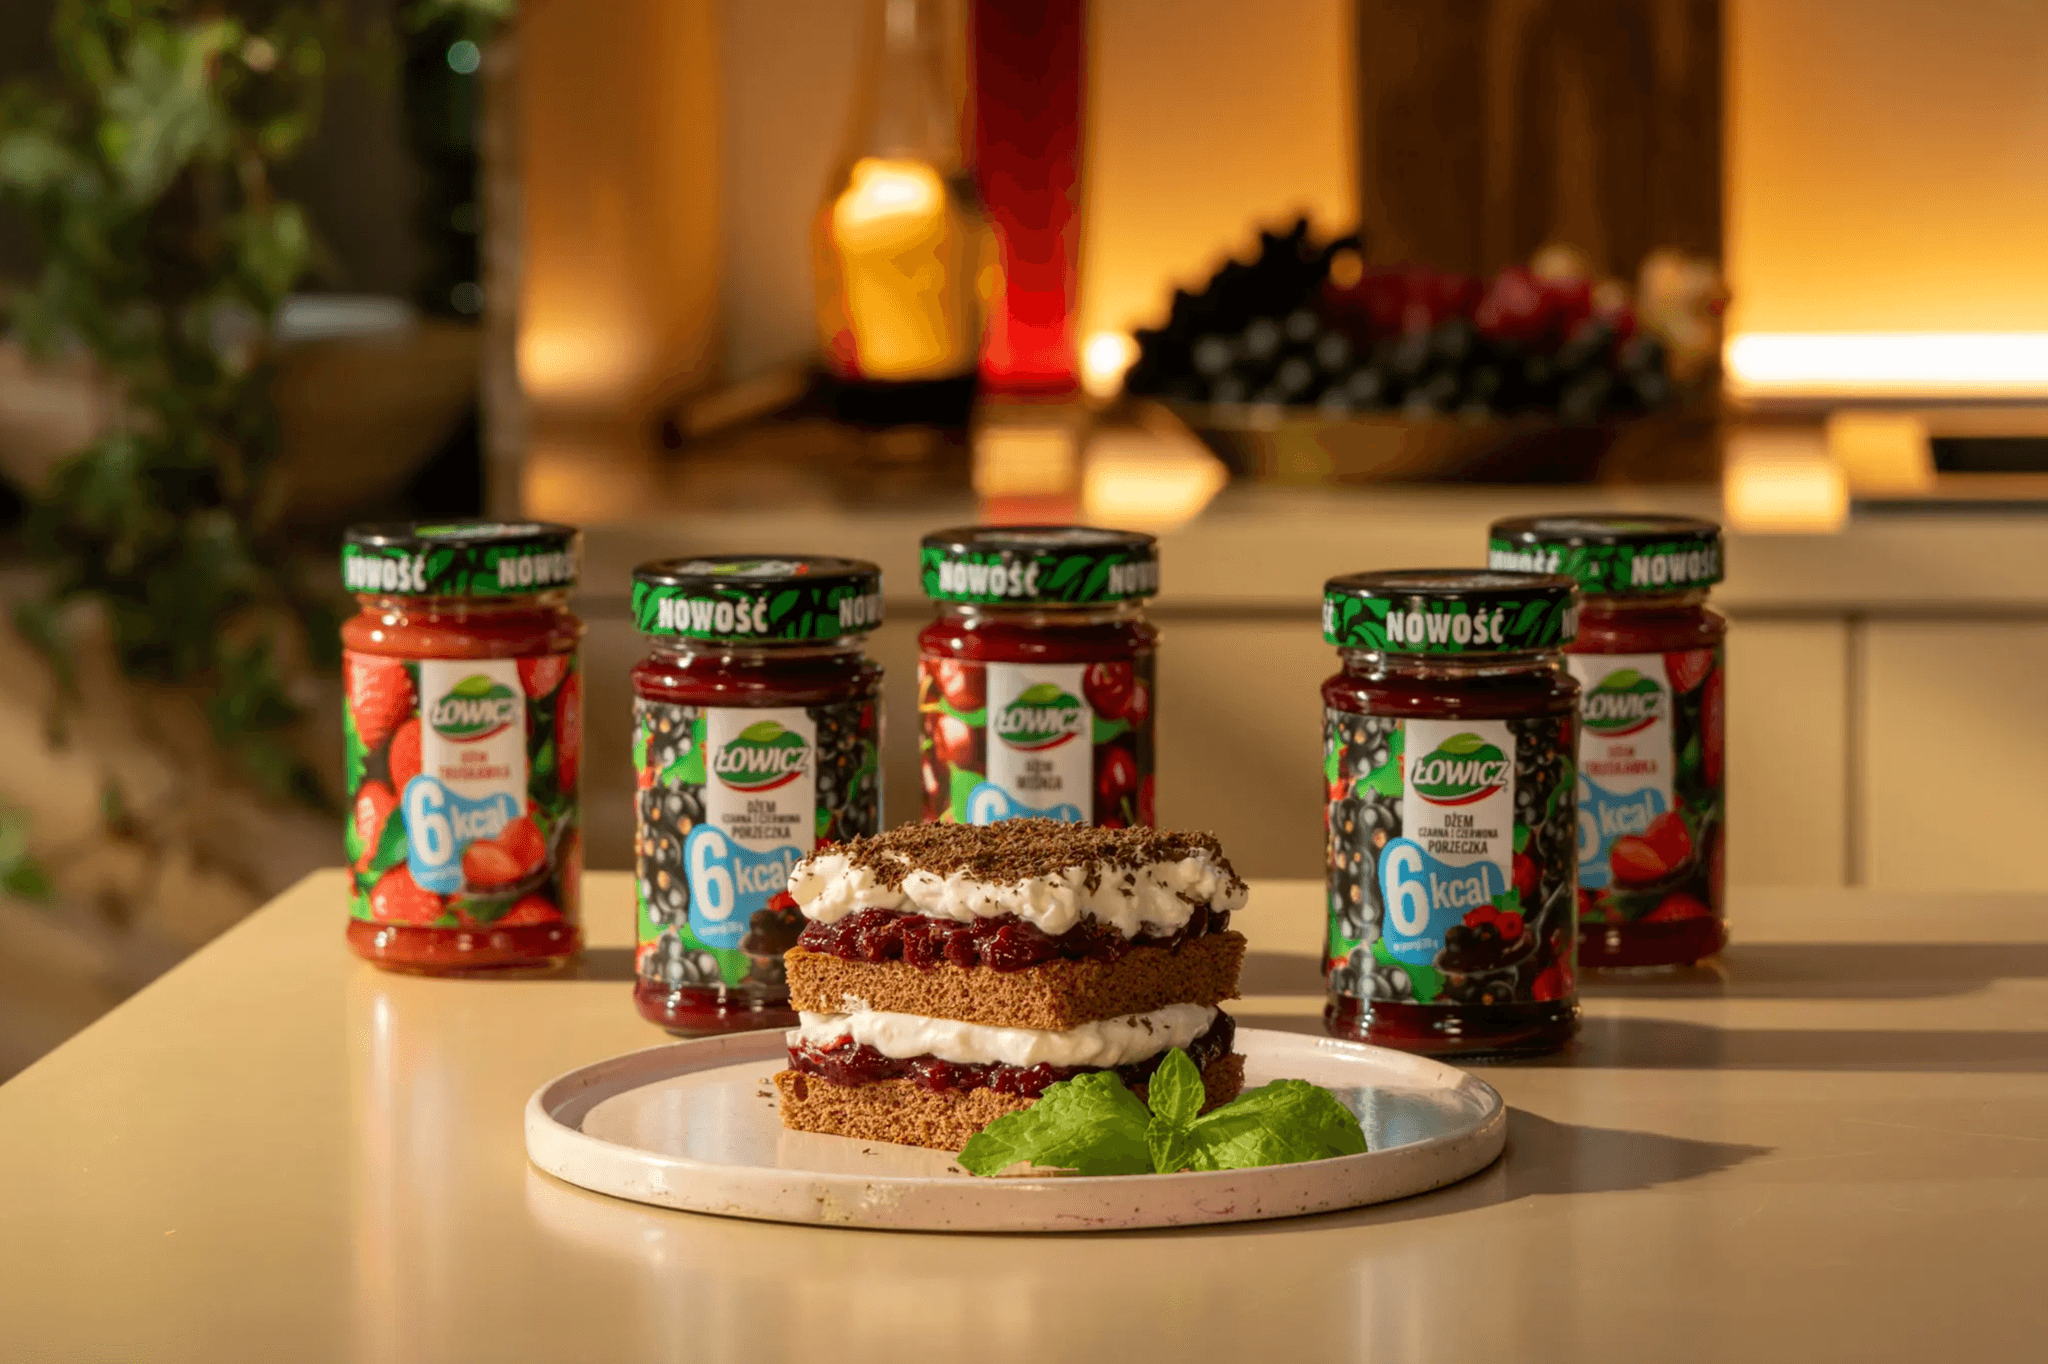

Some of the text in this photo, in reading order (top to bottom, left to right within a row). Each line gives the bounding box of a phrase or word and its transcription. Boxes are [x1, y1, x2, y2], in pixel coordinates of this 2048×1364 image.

[938, 560, 1039, 597] NOWOŚĆ
[658, 597, 768, 633] NOWOŚĆ
[1386, 607, 1504, 644] NOWOŚĆ
[430, 696, 522, 726] ŁOWICZ
[994, 706, 1087, 735] ŁOWICZ
[714, 744, 811, 774] ŁOWICZ
[1411, 757, 1511, 787] ŁOWICZ
[410, 781, 507, 866] 6 kcal
[1444, 811, 1474, 828] DŻEM
[1598, 792, 1654, 836] kcal
[1418, 827, 1449, 838] CZARNA
[1428, 840, 1488, 855] PORZECZKA
[691, 830, 795, 921] 6 kcal
[1386, 845, 1491, 937] 6 kcal
